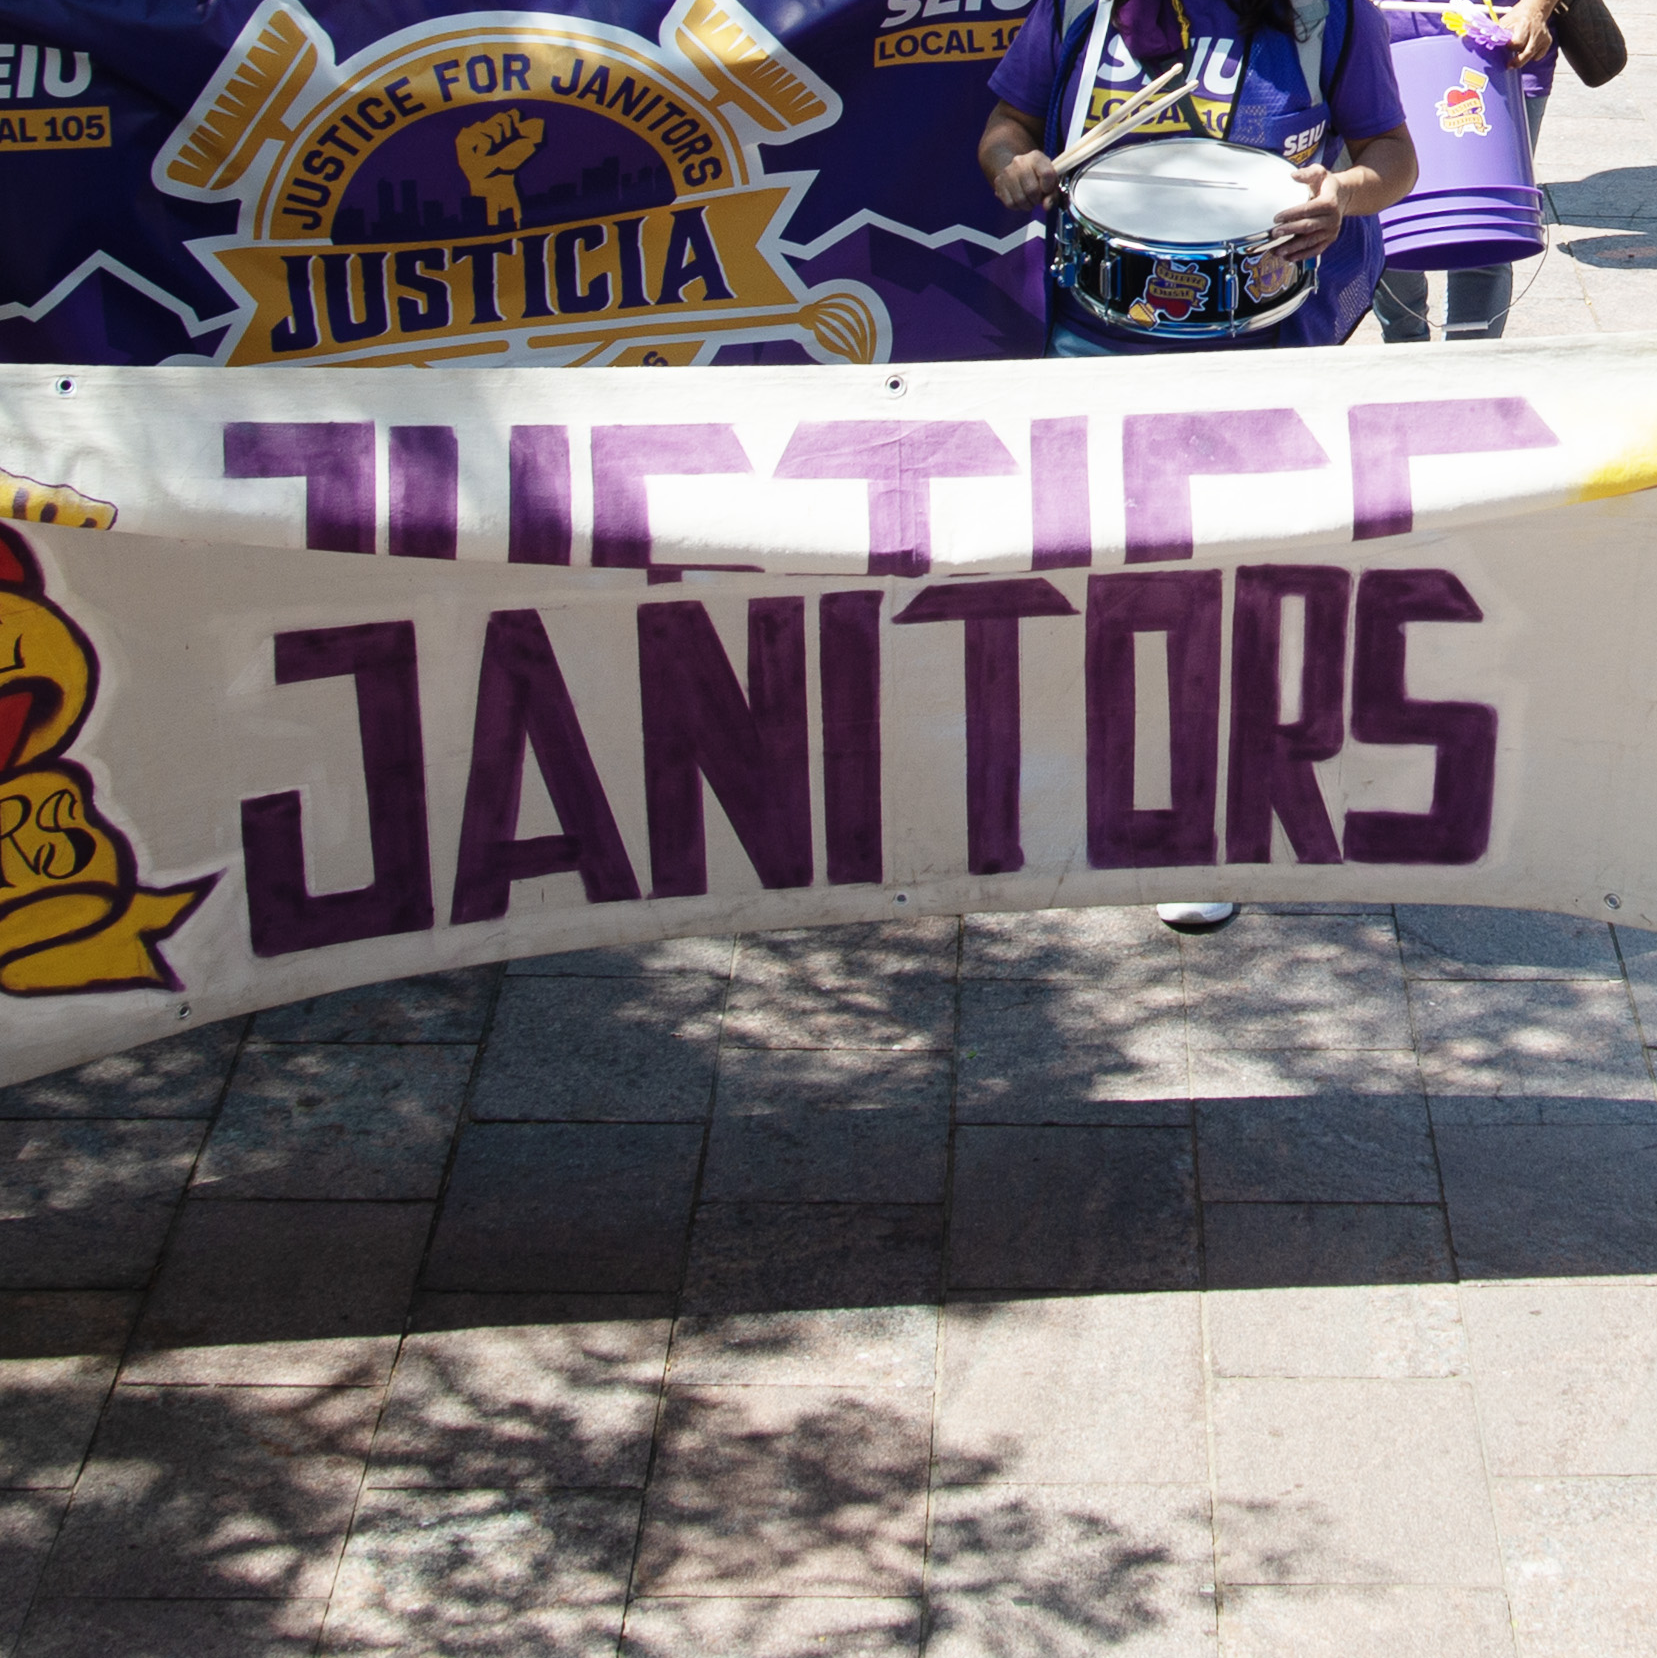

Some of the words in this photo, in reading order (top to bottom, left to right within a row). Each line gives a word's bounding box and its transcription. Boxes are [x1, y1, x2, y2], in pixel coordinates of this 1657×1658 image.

[879, 29, 985, 61] LOCAL
[992, 25, 1024, 51] 10
[45, 115, 105, 142] 105
[282, 77, 426, 231] JUSTICE
[434, 53, 531, 103] FOR
[551, 59, 723, 188] JANITORS
[1202, 111, 1230, 135] 10
[1283, 119, 1327, 157] SEIU
[271, 205, 737, 352] JUSTICIA
[241, 564, 1500, 957] JANITORS
